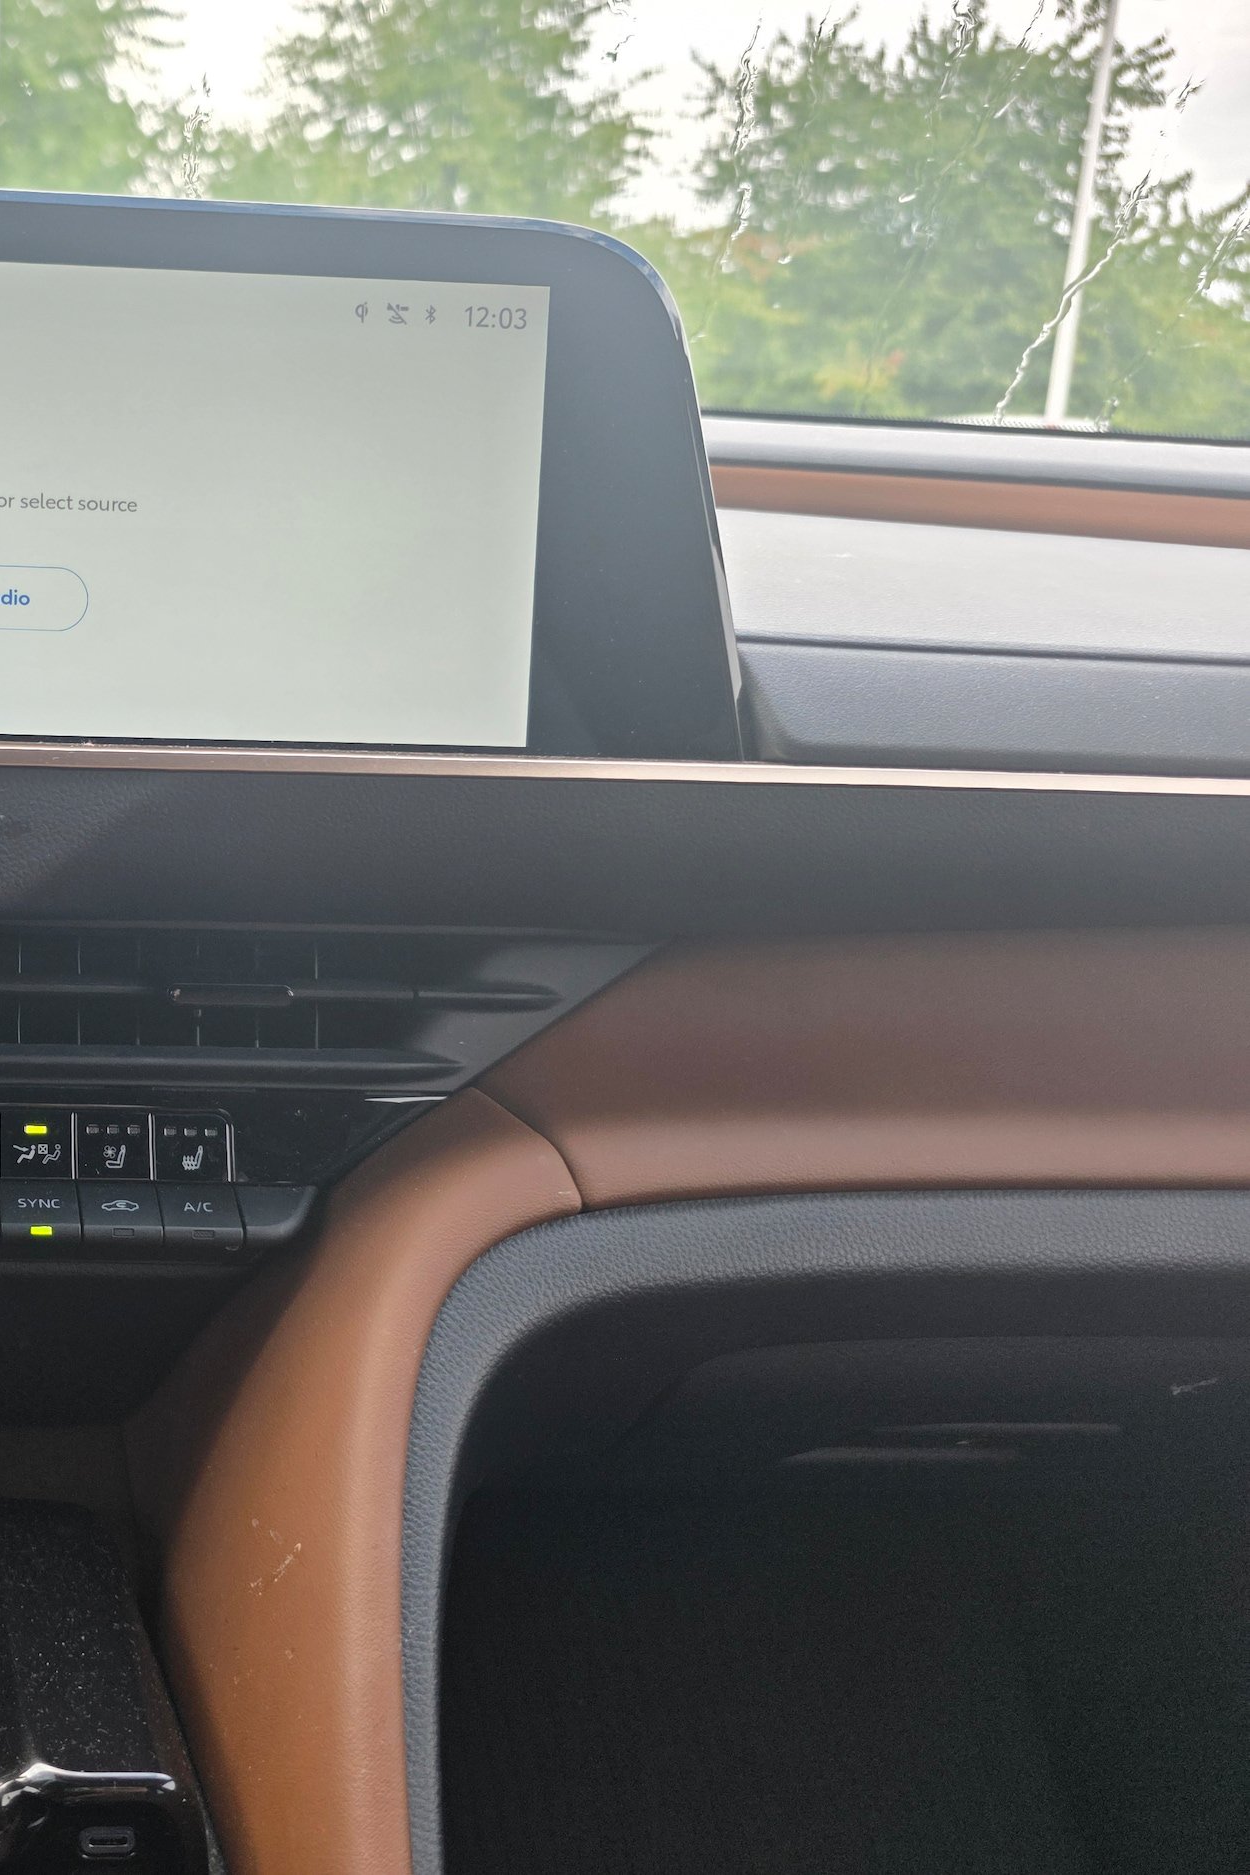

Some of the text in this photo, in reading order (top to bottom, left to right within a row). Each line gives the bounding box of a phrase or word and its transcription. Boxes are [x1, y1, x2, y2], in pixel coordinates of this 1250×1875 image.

[464, 305, 528, 330] 12:03
[20, 493, 73, 511] select
[77, 499, 138, 513] source
[17, 1198, 61, 1209] SYNC
[183, 1202, 214, 1213] A/C
